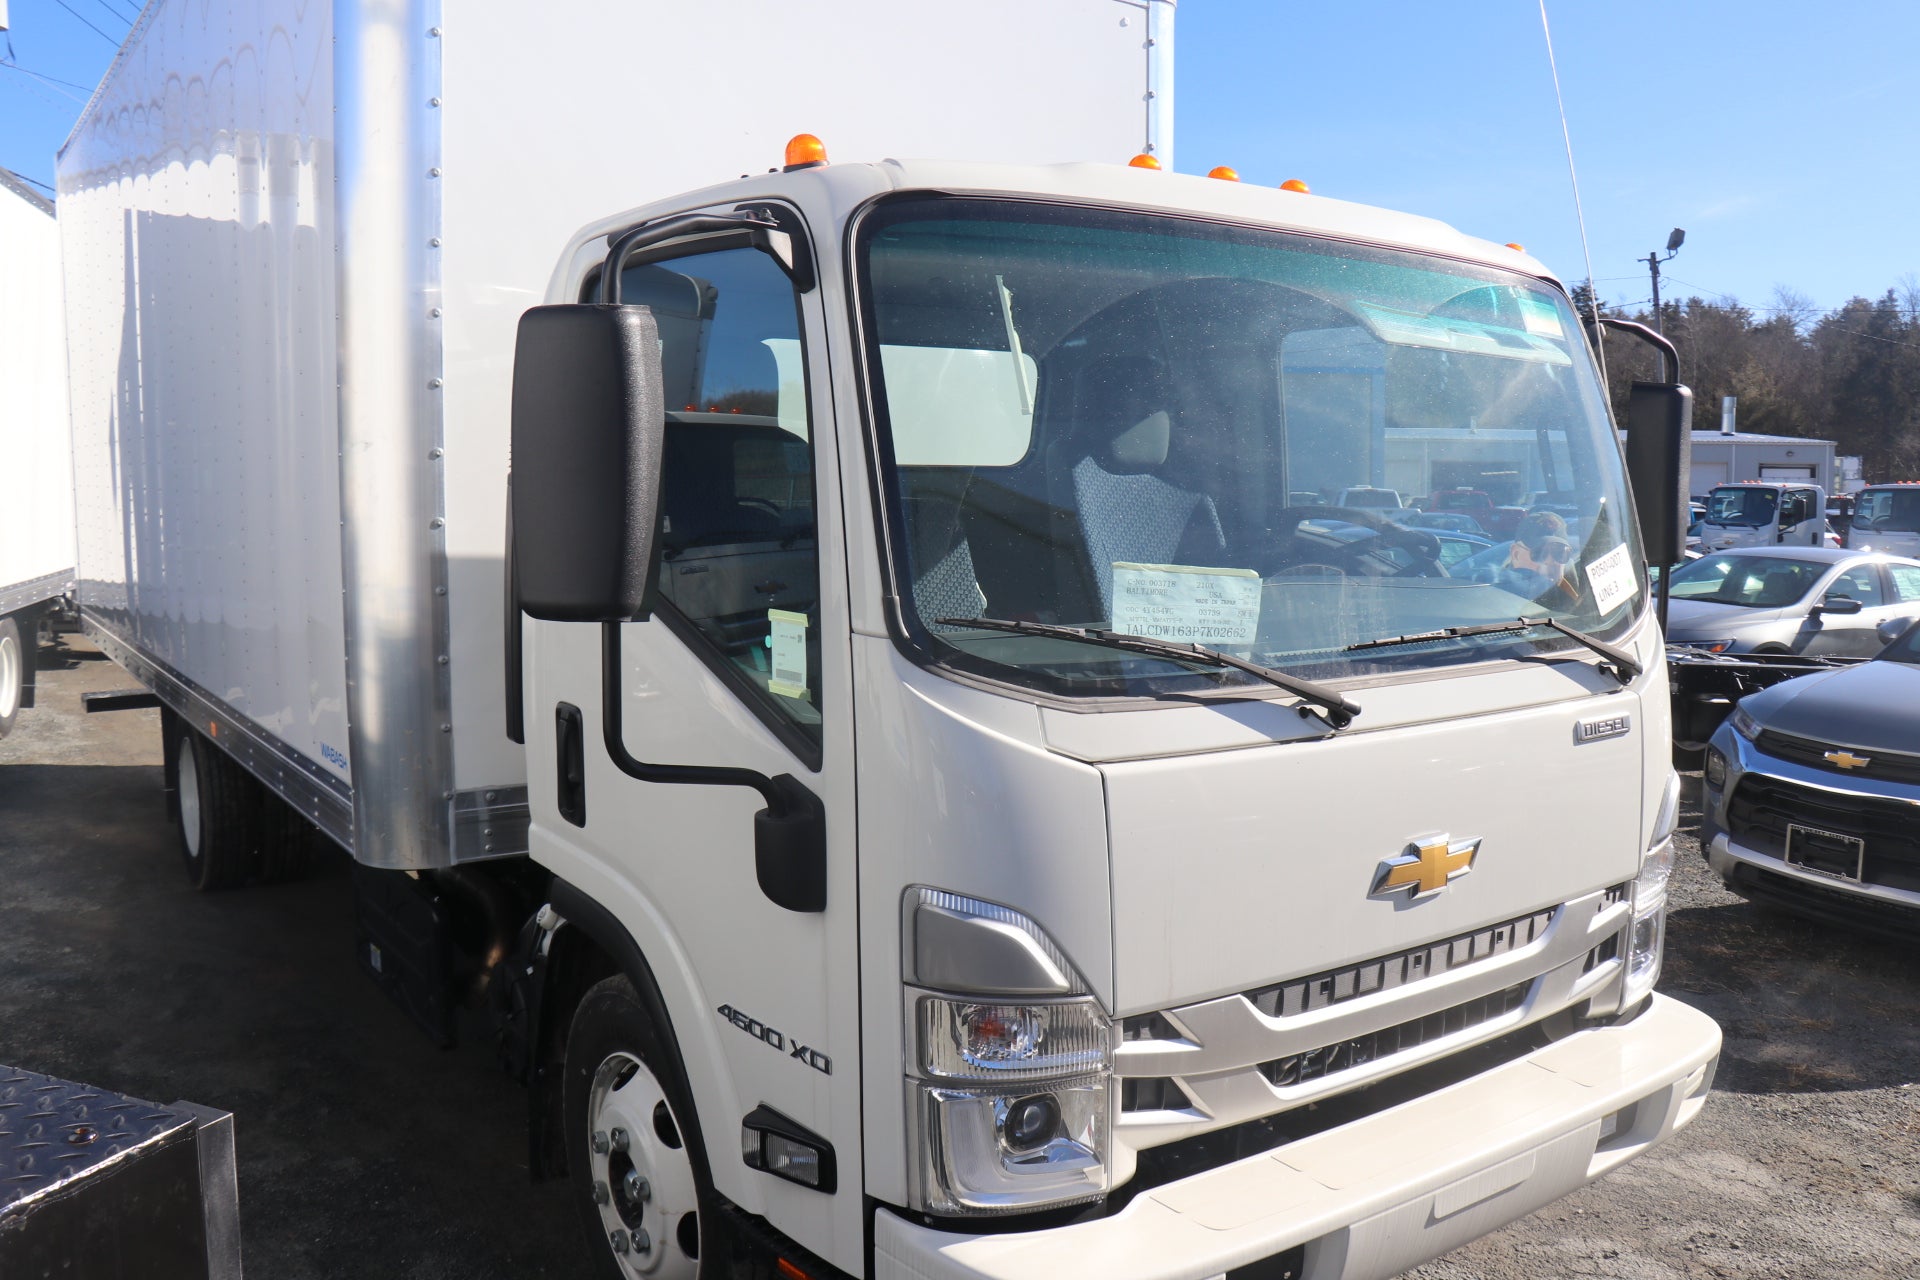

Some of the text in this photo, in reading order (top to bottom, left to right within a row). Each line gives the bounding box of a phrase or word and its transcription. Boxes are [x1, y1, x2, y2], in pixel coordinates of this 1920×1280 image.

[1209, 591, 1223, 599] USA
[1599, 580, 1619, 602] LINE 3
[1584, 717, 1628, 737] DIESEL
[717, 1003, 832, 1076] 4500 XD
